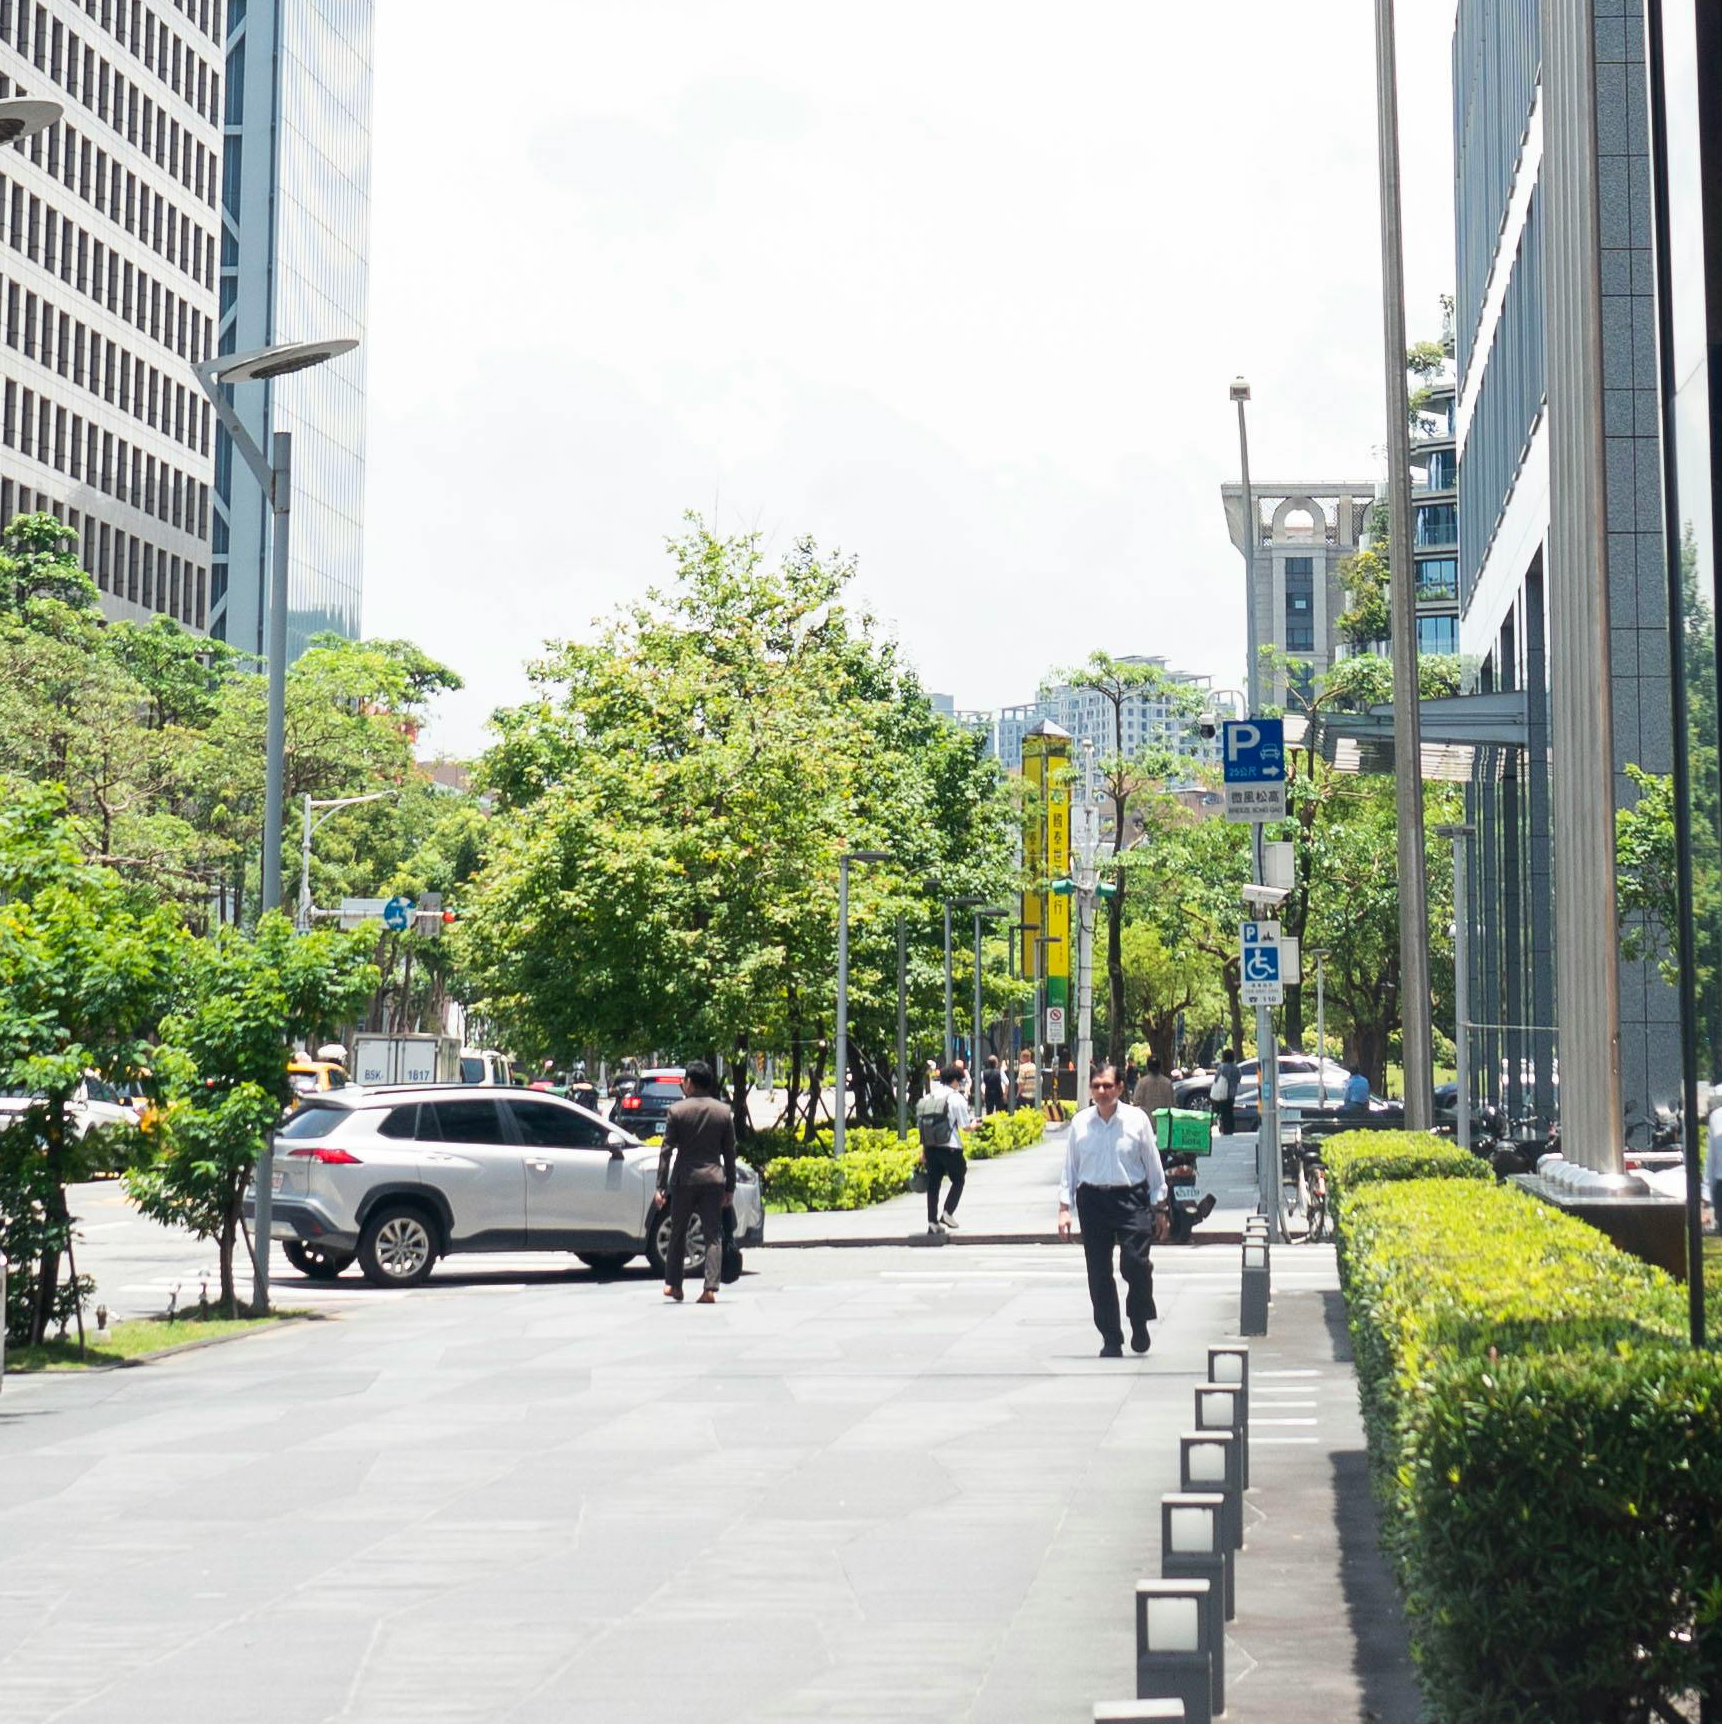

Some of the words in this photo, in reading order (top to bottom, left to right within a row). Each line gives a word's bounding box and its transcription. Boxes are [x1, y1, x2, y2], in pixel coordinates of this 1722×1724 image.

[1228, 724, 1260, 762] P
[1246, 926, 1256, 940] P
[408, 1070, 430, 1081] 1817
